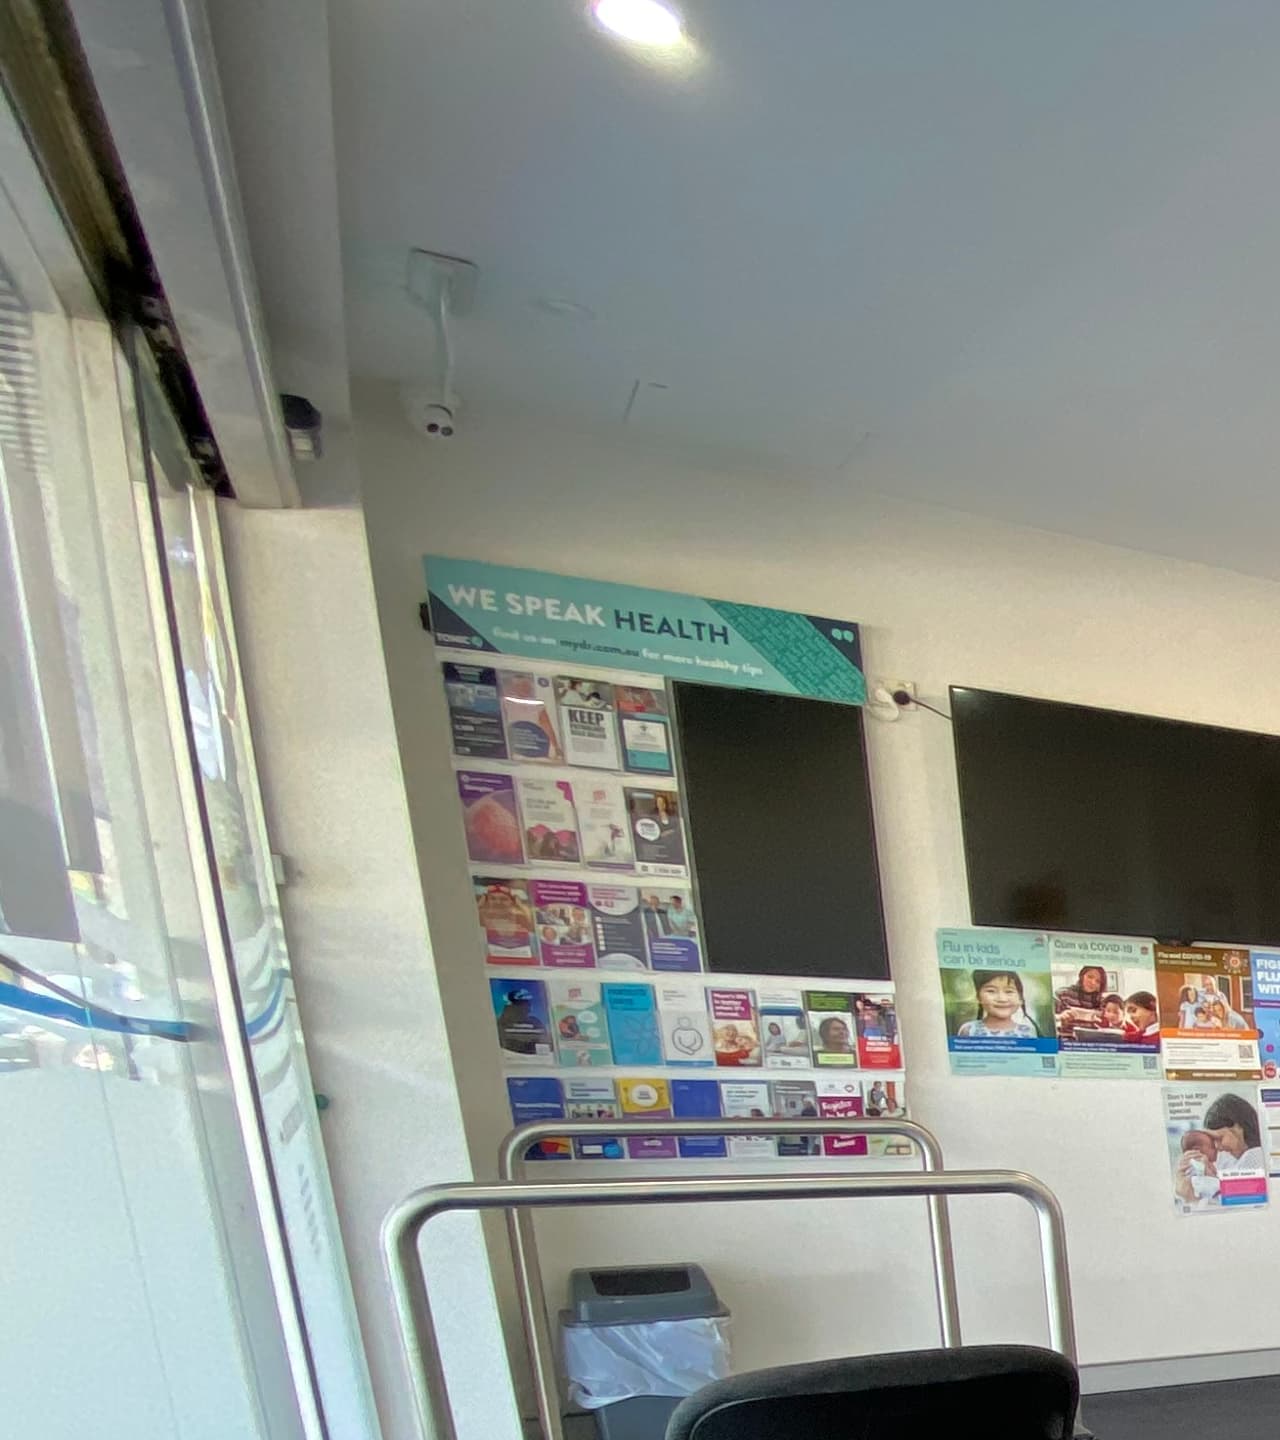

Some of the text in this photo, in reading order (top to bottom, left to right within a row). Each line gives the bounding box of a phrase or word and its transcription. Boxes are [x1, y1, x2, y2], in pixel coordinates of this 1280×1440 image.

[448, 583, 729, 645] WE SPEAK HEALTH
[569, 709, 605, 725] KEEP
[943, 940, 1000, 955] Flu in kids
[1090, 941, 1133, 954] COVID-19
[943, 953, 1026, 968] can be serious
[1182, 953, 1212, 961] COVID-19
[1257, 971, 1280, 982] FLU
